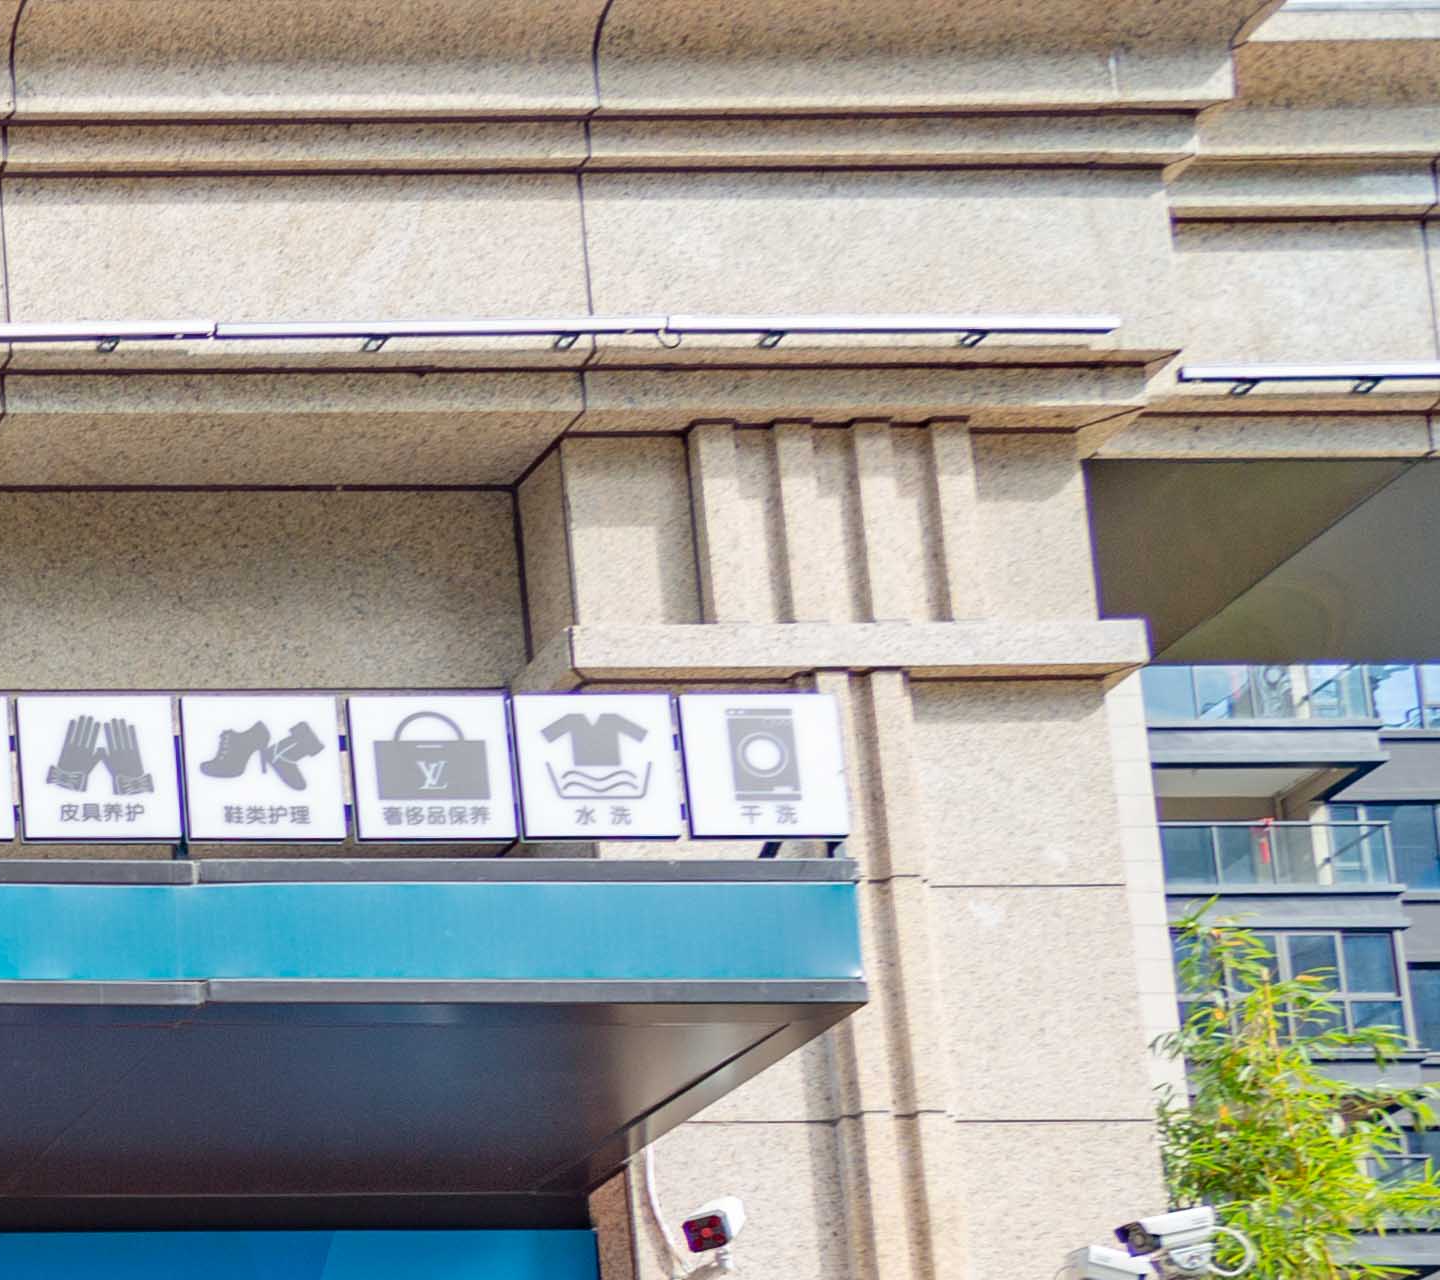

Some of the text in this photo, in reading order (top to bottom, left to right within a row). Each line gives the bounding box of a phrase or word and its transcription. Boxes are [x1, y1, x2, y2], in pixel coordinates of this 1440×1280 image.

[60, 802, 145, 823] 皮具养护
[224, 806, 311, 826] 鞋类护理
[383, 806, 491, 827] 奢侈品保养
